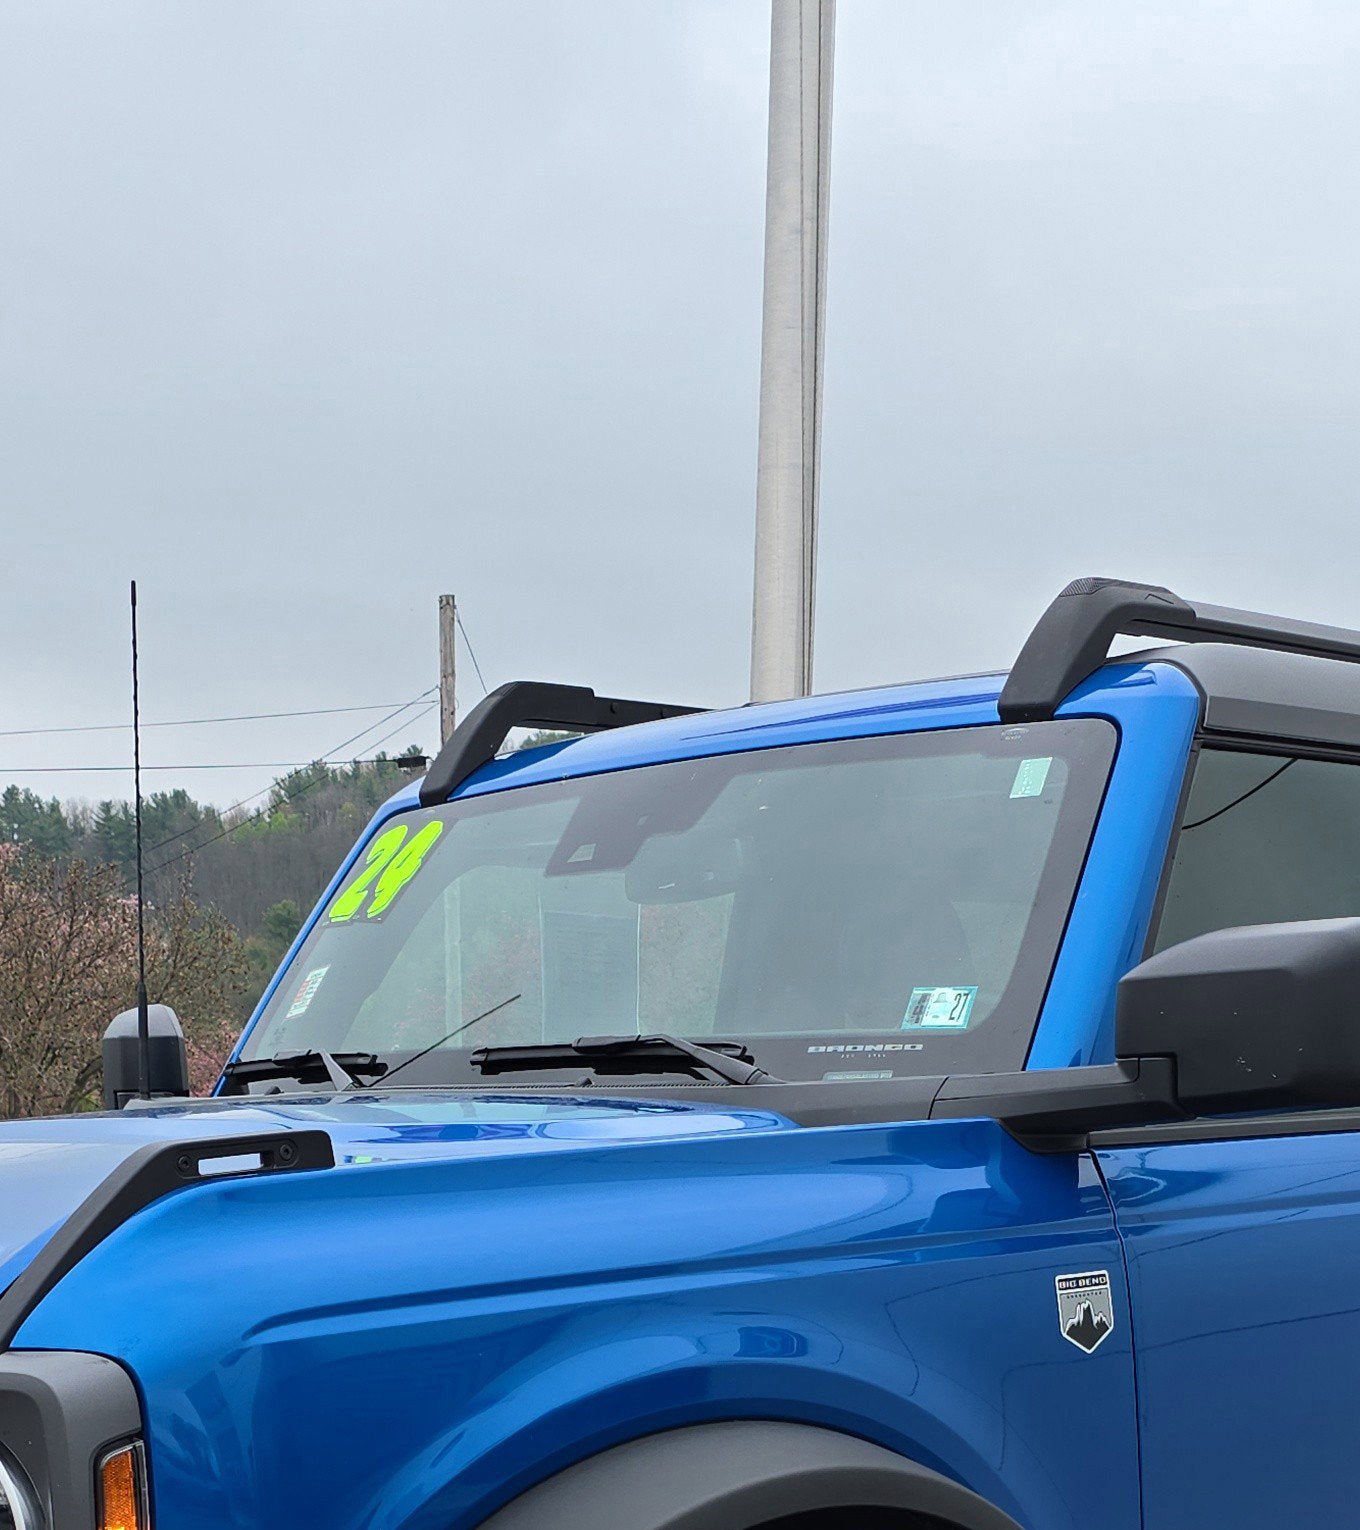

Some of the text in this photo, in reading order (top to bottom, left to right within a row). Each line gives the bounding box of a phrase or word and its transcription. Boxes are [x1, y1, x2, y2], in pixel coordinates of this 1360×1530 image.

[329, 821, 443, 922] 24
[807, 1044, 924, 1053] BRONCO
[1059, 1276, 1107, 1289] BIG BEND
